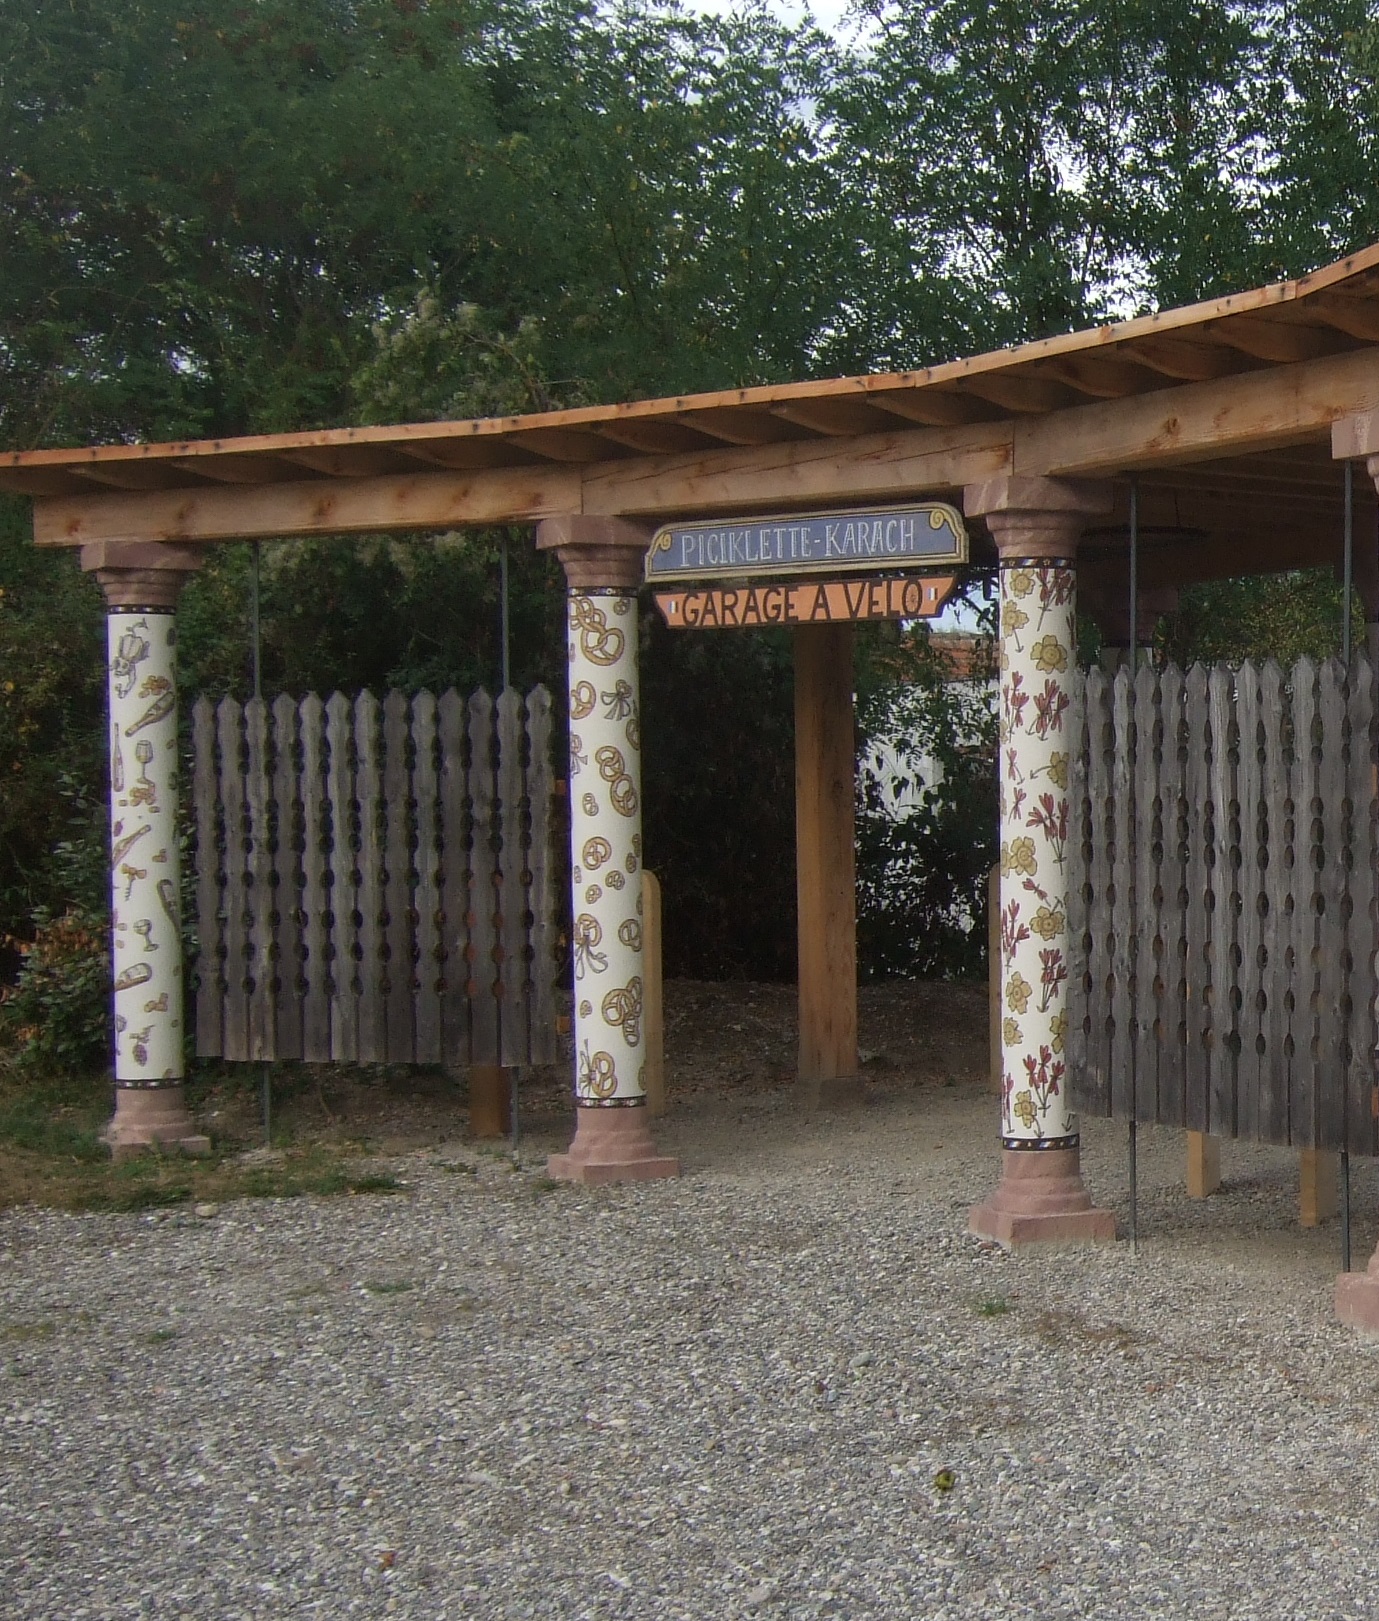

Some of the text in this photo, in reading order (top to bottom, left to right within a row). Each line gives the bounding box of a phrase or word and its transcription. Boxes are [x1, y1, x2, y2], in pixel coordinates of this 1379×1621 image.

[682, 577, 923, 627] GARAGE A VELO
